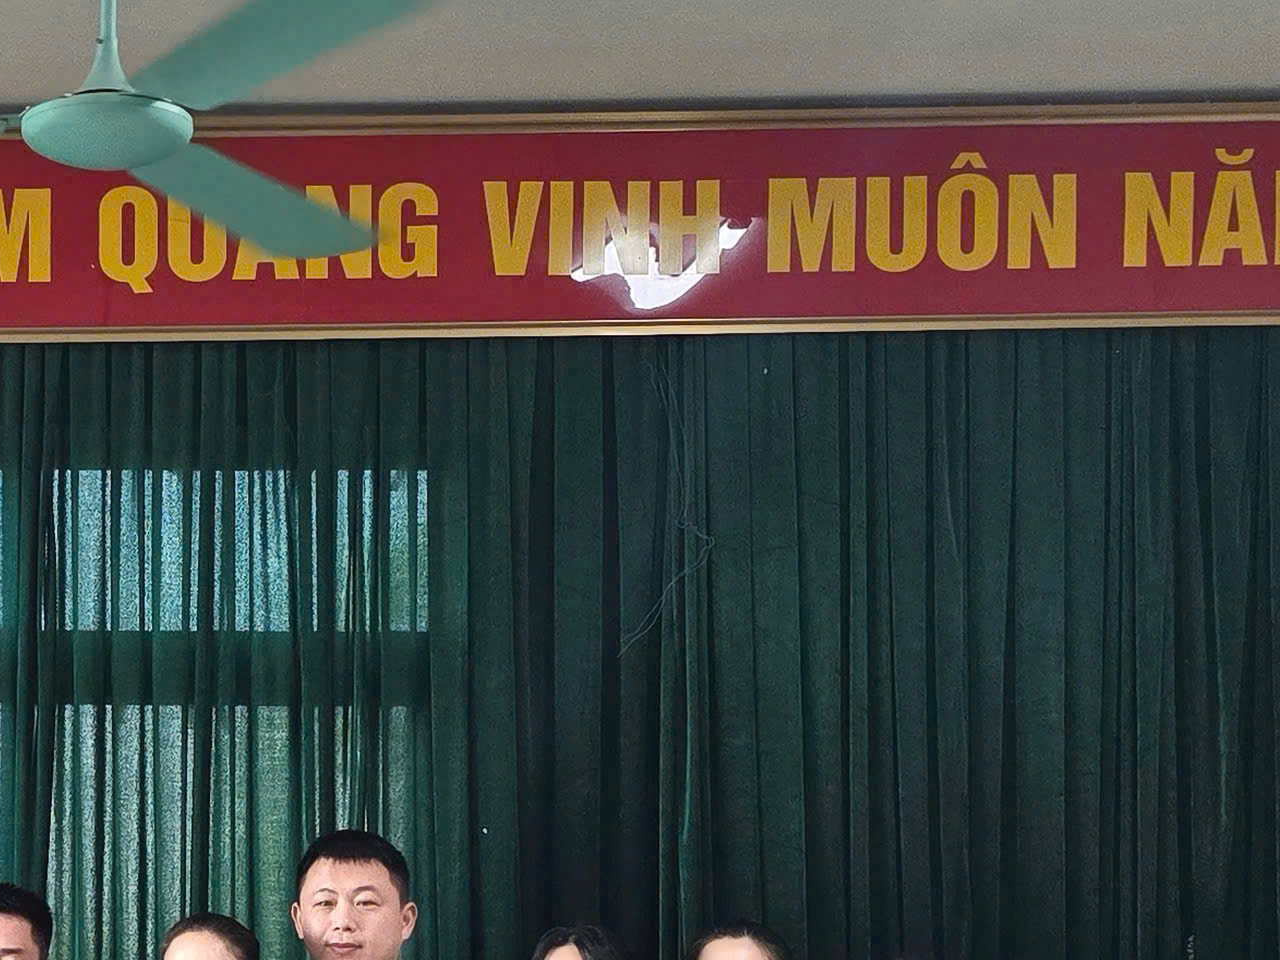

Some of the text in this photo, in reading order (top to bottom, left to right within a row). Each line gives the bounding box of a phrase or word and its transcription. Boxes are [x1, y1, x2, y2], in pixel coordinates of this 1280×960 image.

[482, 179, 722, 278] VINH
[766, 151, 1078, 274] MUÔN
[1122, 147, 1280, 268] NĂ
